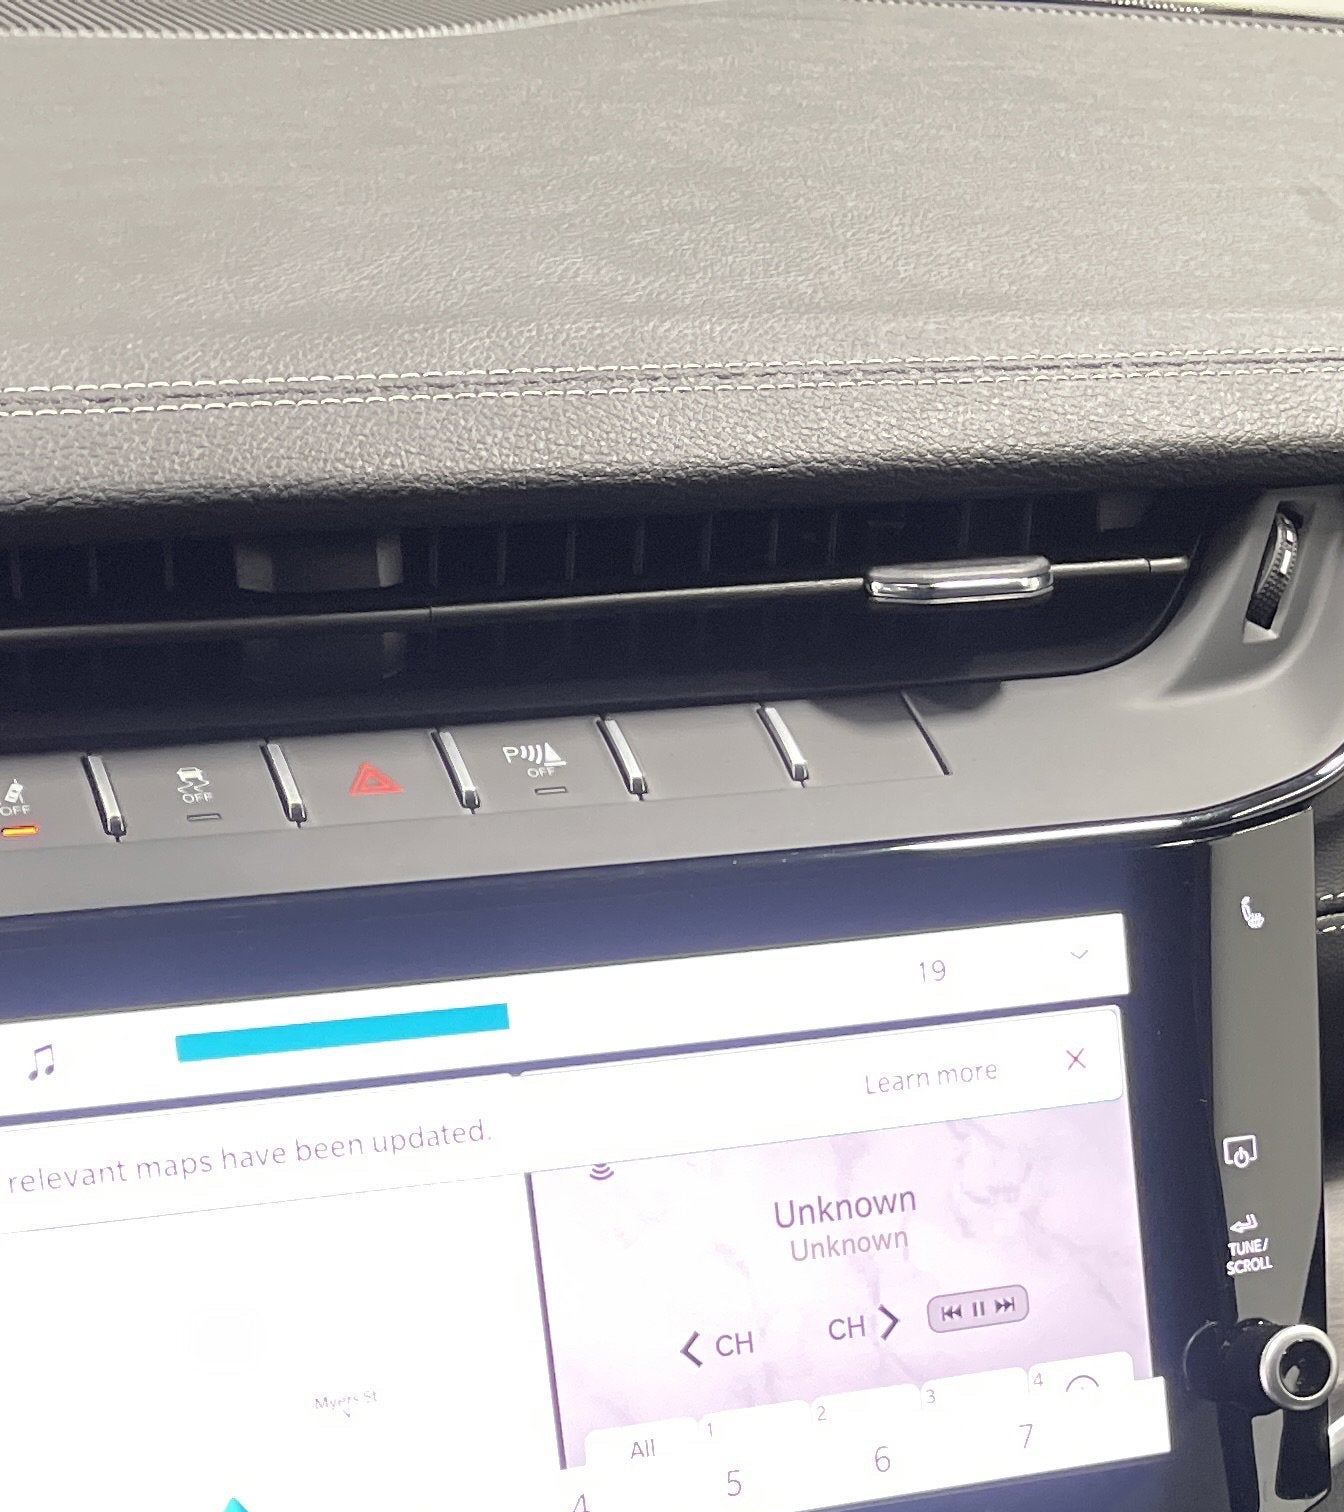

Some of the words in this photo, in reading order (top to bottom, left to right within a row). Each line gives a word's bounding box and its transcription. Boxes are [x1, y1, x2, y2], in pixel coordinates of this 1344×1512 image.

[527, 766, 556, 779] OFF
[181, 791, 214, 805] OFF
[918, 959, 947, 984] 19
[864, 1067, 930, 1096] Learn
[938, 1061, 999, 1086] more
[8, 1159, 129, 1196] relevant
[136, 1149, 214, 1183] maps
[221, 1140, 288, 1170] have
[296, 1131, 364, 1162] been
[372, 1118, 493, 1158] updated.
[774, 1186, 918, 1229] Unknown
[789, 1229, 910, 1264] Unknown
[1228, 1239, 1269, 1258] TUNE/
[1226, 1256, 1273, 1276] SCROLL
[828, 1315, 867, 1342] CH
[715, 1331, 755, 1358] CH
[630, 1437, 656, 1461] All
[817, 1406, 828, 1422] 2
[925, 1389, 937, 1404] 3
[1033, 1372, 1044, 1388] 4
[725, 1470, 743, 1497] 5
[873, 1446, 891, 1474] 6
[1018, 1424, 1034, 1451] 7
